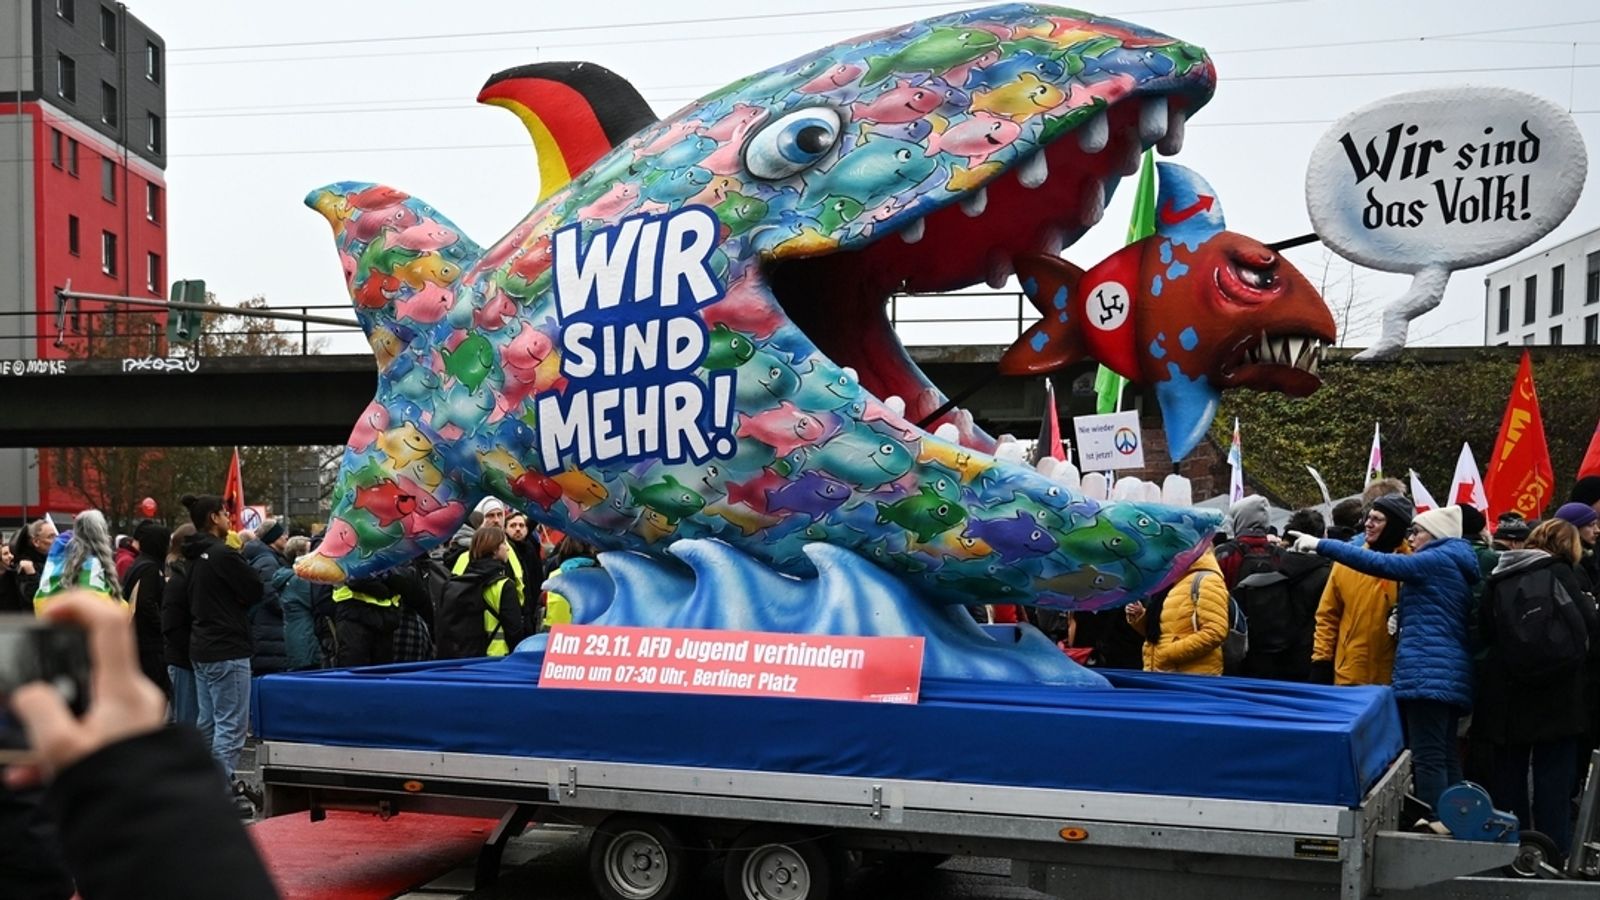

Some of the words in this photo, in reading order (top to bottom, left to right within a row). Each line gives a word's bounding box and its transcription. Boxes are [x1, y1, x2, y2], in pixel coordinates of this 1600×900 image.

[1338, 123, 1448, 185] Wir
[1453, 120, 1540, 170] sind
[1362, 187, 1429, 230] das
[1431, 174, 1532, 225] Volk!
[554, 208, 719, 320] WIR
[563, 317, 705, 379] SIND
[538, 375, 732, 472] MEHR!
[1078, 426, 1090, 435] Nie
[1091, 424, 1114, 433] wieder
[544, 662, 585, 680] Demo
[588, 666, 612, 682] um
[615, 665, 656, 683] 07:30
[659, 667, 688, 687] Uhr,
[692, 669, 755, 690] Berliner
[757, 672, 798, 693] Platz
[550, 632, 580, 654] Am
[583, 634, 631, 657] 29.11.
[637, 636, 672, 658] AFD
[674, 638, 749, 662] Jugend
[753, 642, 865, 669] verhindern
